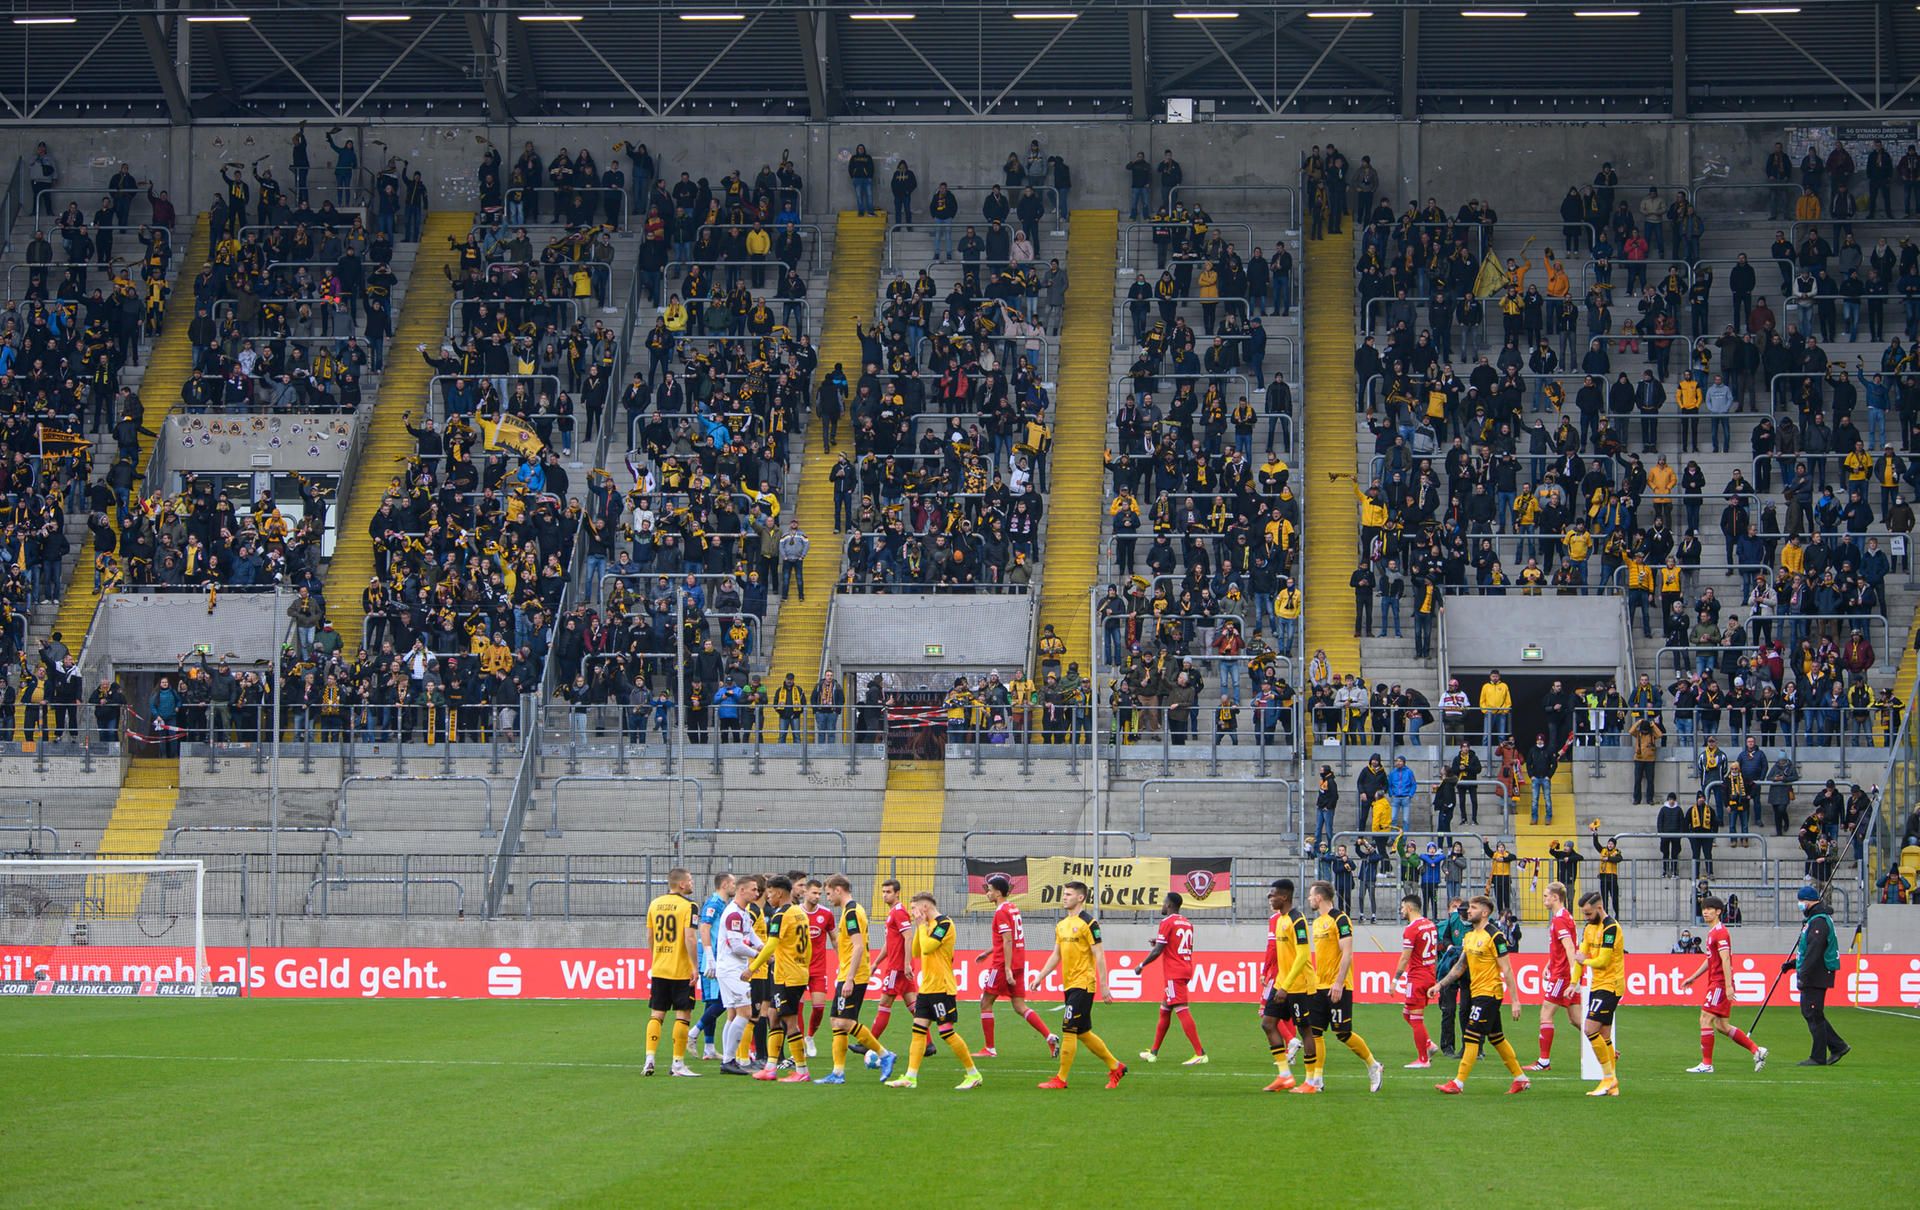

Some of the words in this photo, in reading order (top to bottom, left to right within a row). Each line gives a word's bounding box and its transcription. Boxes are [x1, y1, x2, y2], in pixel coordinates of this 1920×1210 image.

[1041, 885, 1063, 903] DI
[655, 914, 677, 943] 39
[1176, 928, 1193, 955] 20
[1422, 930, 1437, 958] 25
[217, 957, 266, 988] als
[274, 958, 350, 989] Geld
[359, 958, 447, 996] geht.
[560, 959, 652, 990] Weil'
[1626, 964, 1694, 995] eht.
[933, 1002, 947, 1018] 19
[1293, 1003, 1300, 1018] 3
[1331, 1008, 1343, 1023] 21
[1469, 1005, 1481, 1020] 25
[1590, 999, 1602, 1012] 17
